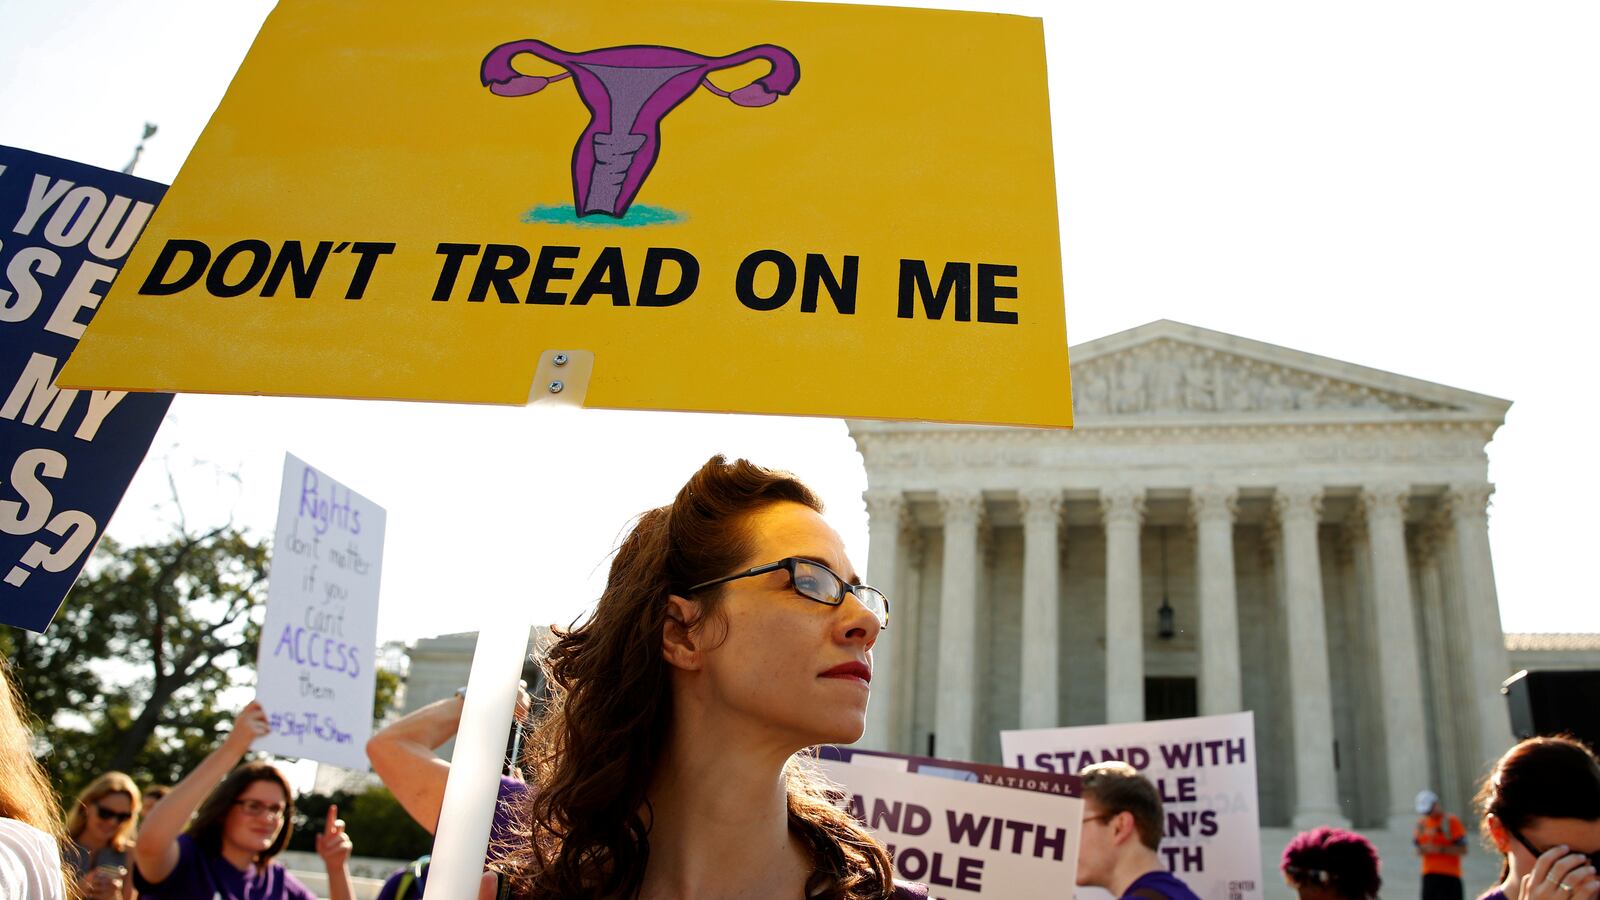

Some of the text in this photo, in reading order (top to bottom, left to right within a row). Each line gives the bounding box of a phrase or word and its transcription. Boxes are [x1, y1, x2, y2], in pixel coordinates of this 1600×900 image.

[13, 173, 154, 260] YOU
[0, 246, 118, 340] SE
[138, 239, 1019, 324] DON'T TREAD ON ME
[0, 351, 129, 442] MY
[0, 448, 97, 588] S?
[273, 623, 361, 679] ACCESS
[1159, 738, 1246, 769] WITH
[983, 774, 1072, 795] NATIONAL
[1157, 777, 1197, 803] LE
[845, 794, 1067, 861] AND WITH
[886, 844, 984, 892] OLE
[1161, 845, 1204, 872] TH
